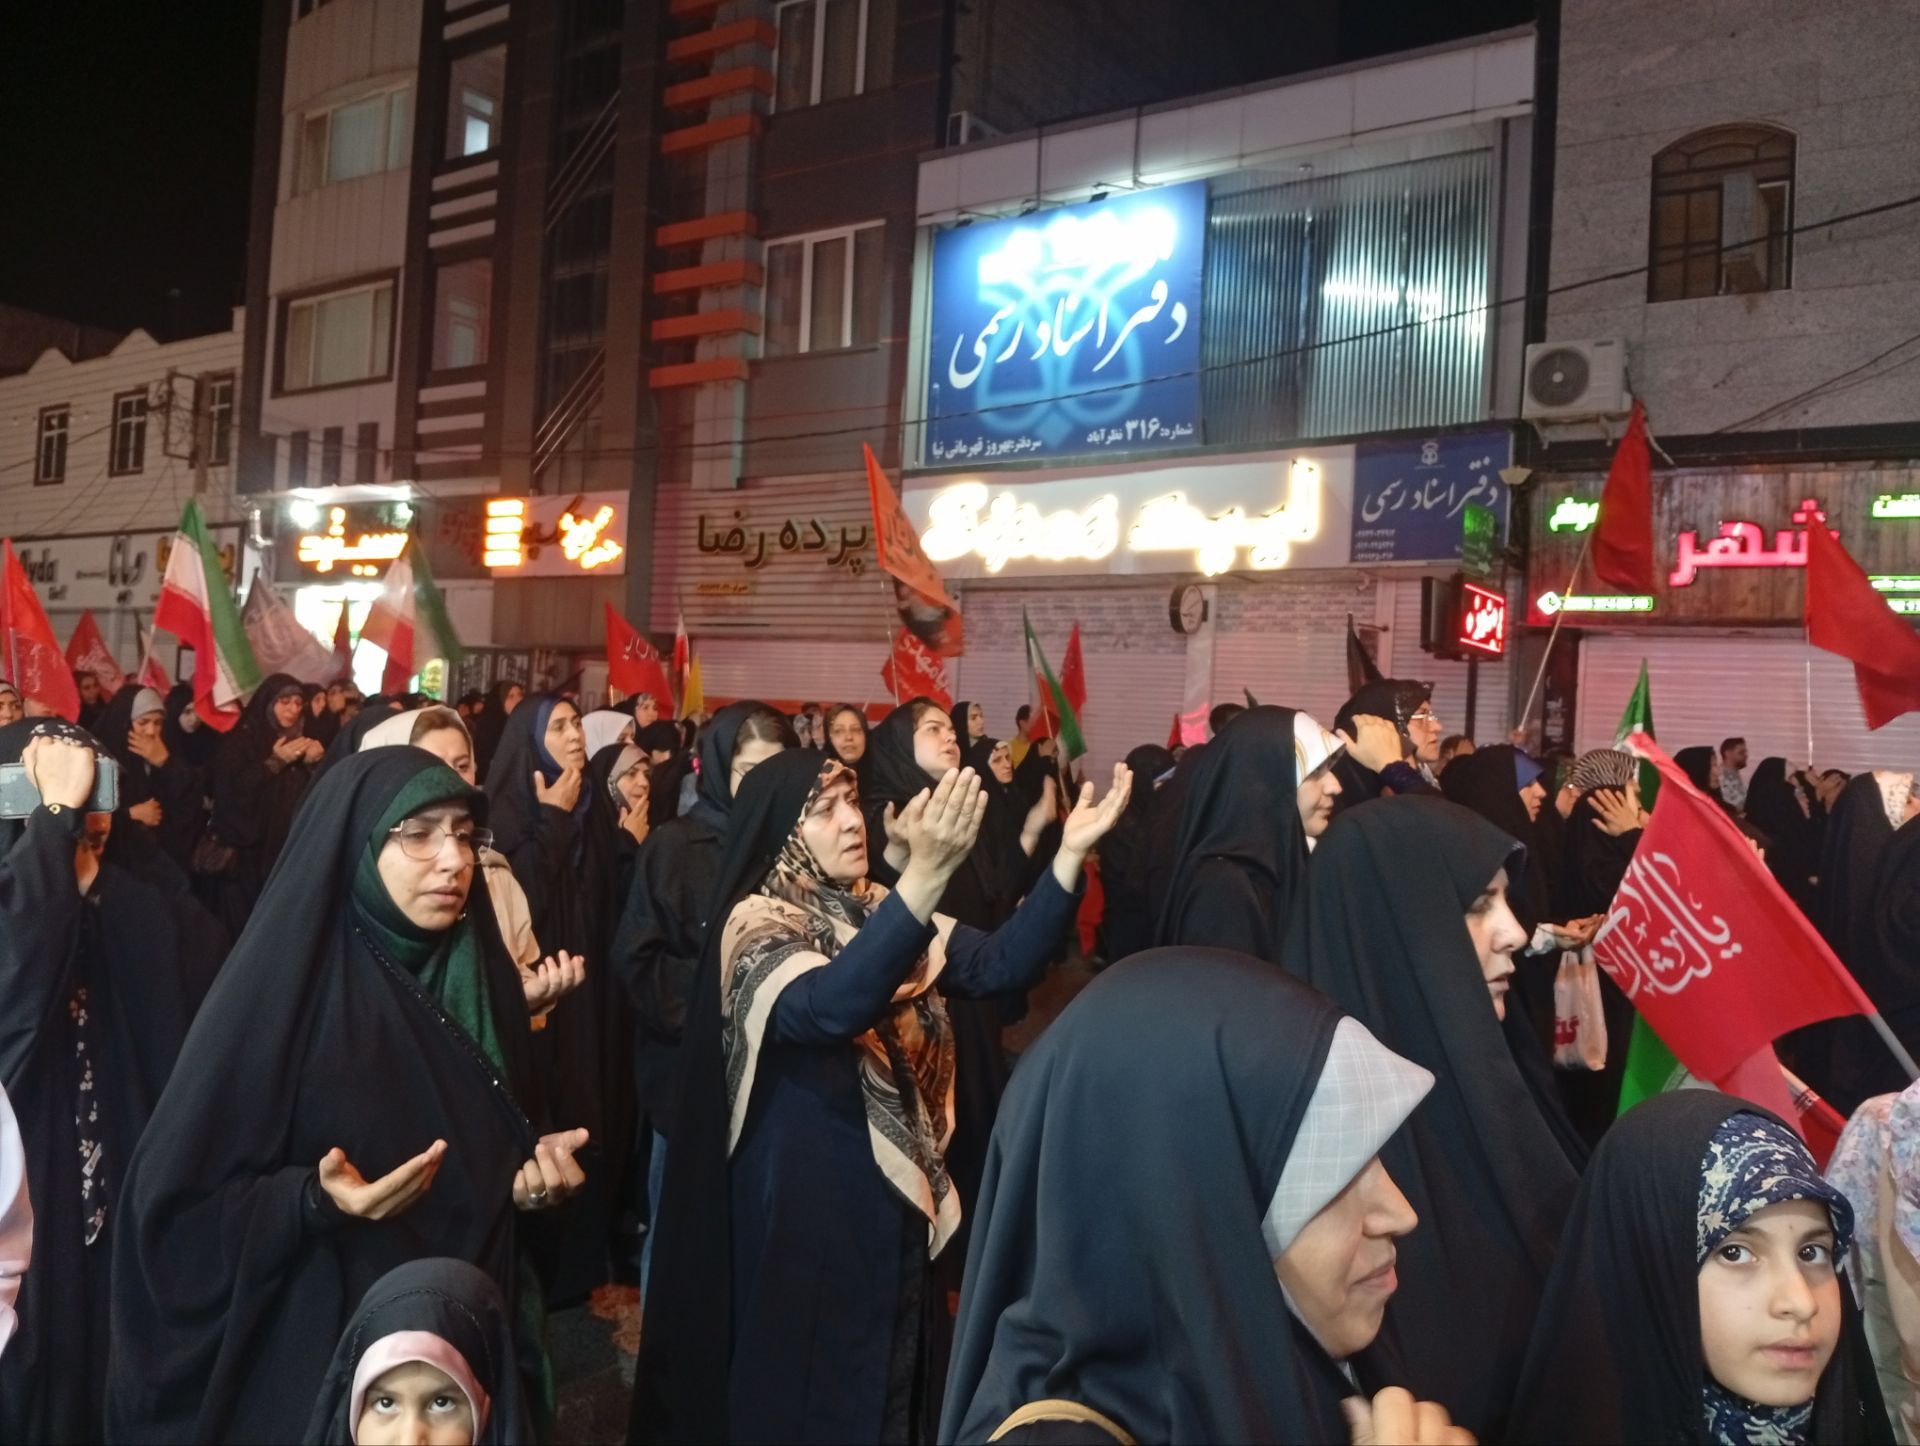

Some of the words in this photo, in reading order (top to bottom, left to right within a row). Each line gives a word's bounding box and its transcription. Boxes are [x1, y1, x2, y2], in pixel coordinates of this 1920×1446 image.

[1125, 417, 1160, 441] ۳۱۶
[1361, 479, 1407, 523] رسمی
[1409, 478, 1456, 511] اسناد
[1446, 456, 1499, 518] دفتر
[698, 510, 766, 568] رضا
[779, 519, 868, 574] پرده
